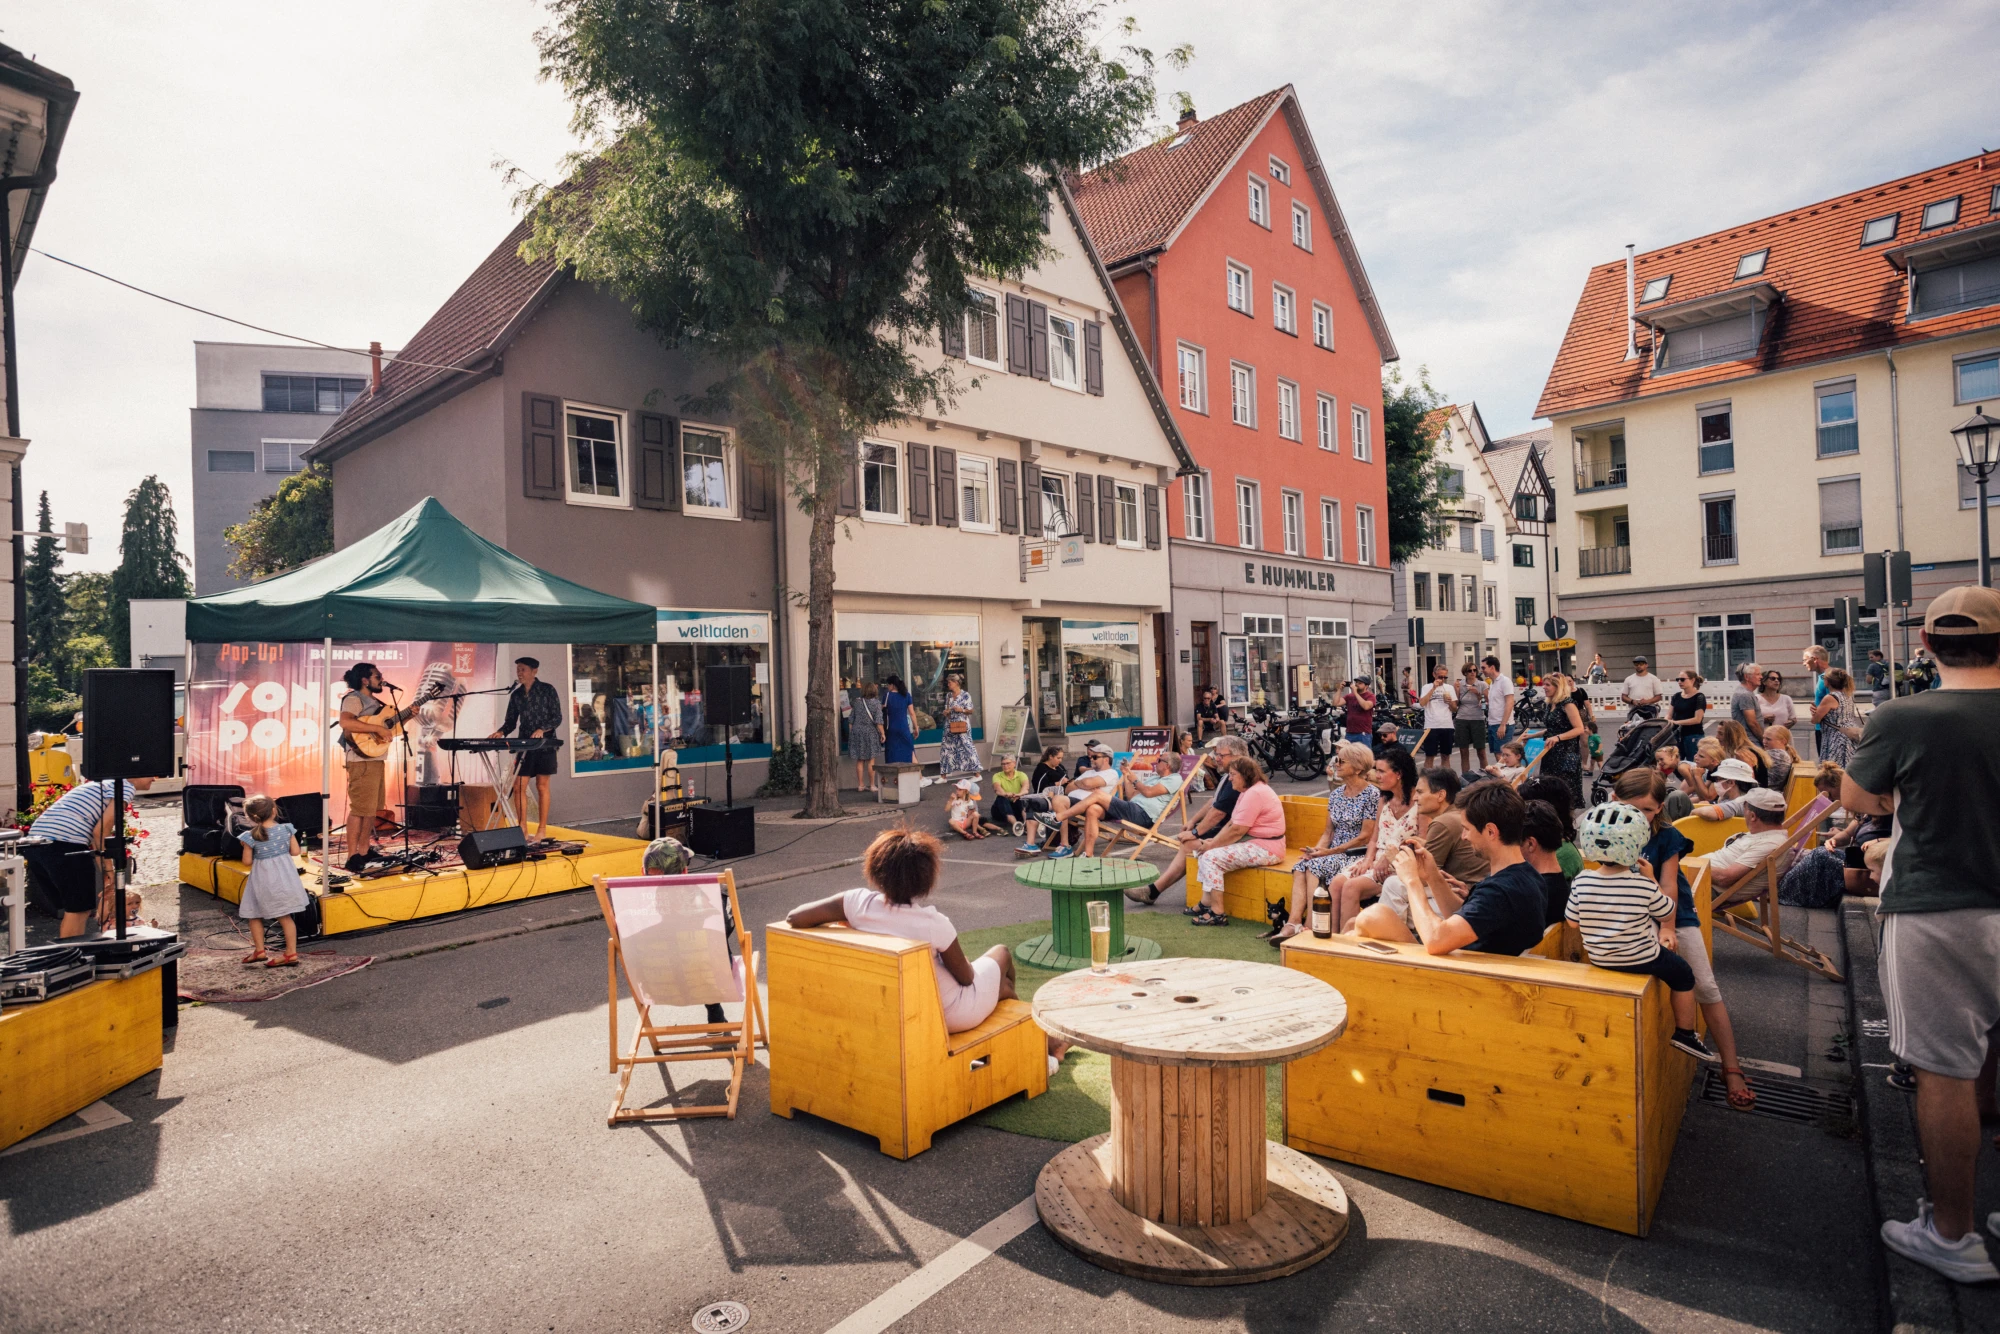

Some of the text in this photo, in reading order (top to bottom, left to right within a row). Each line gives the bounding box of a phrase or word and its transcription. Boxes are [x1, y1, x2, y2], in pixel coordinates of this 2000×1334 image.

[1245, 563, 1336, 592] E HUMMLER
[678, 624, 749, 639] weltladen
[1092, 630, 1129, 641] weltladen
[220, 643, 284, 665] Pop-Up!
[368, 649, 403, 661] FREI:
